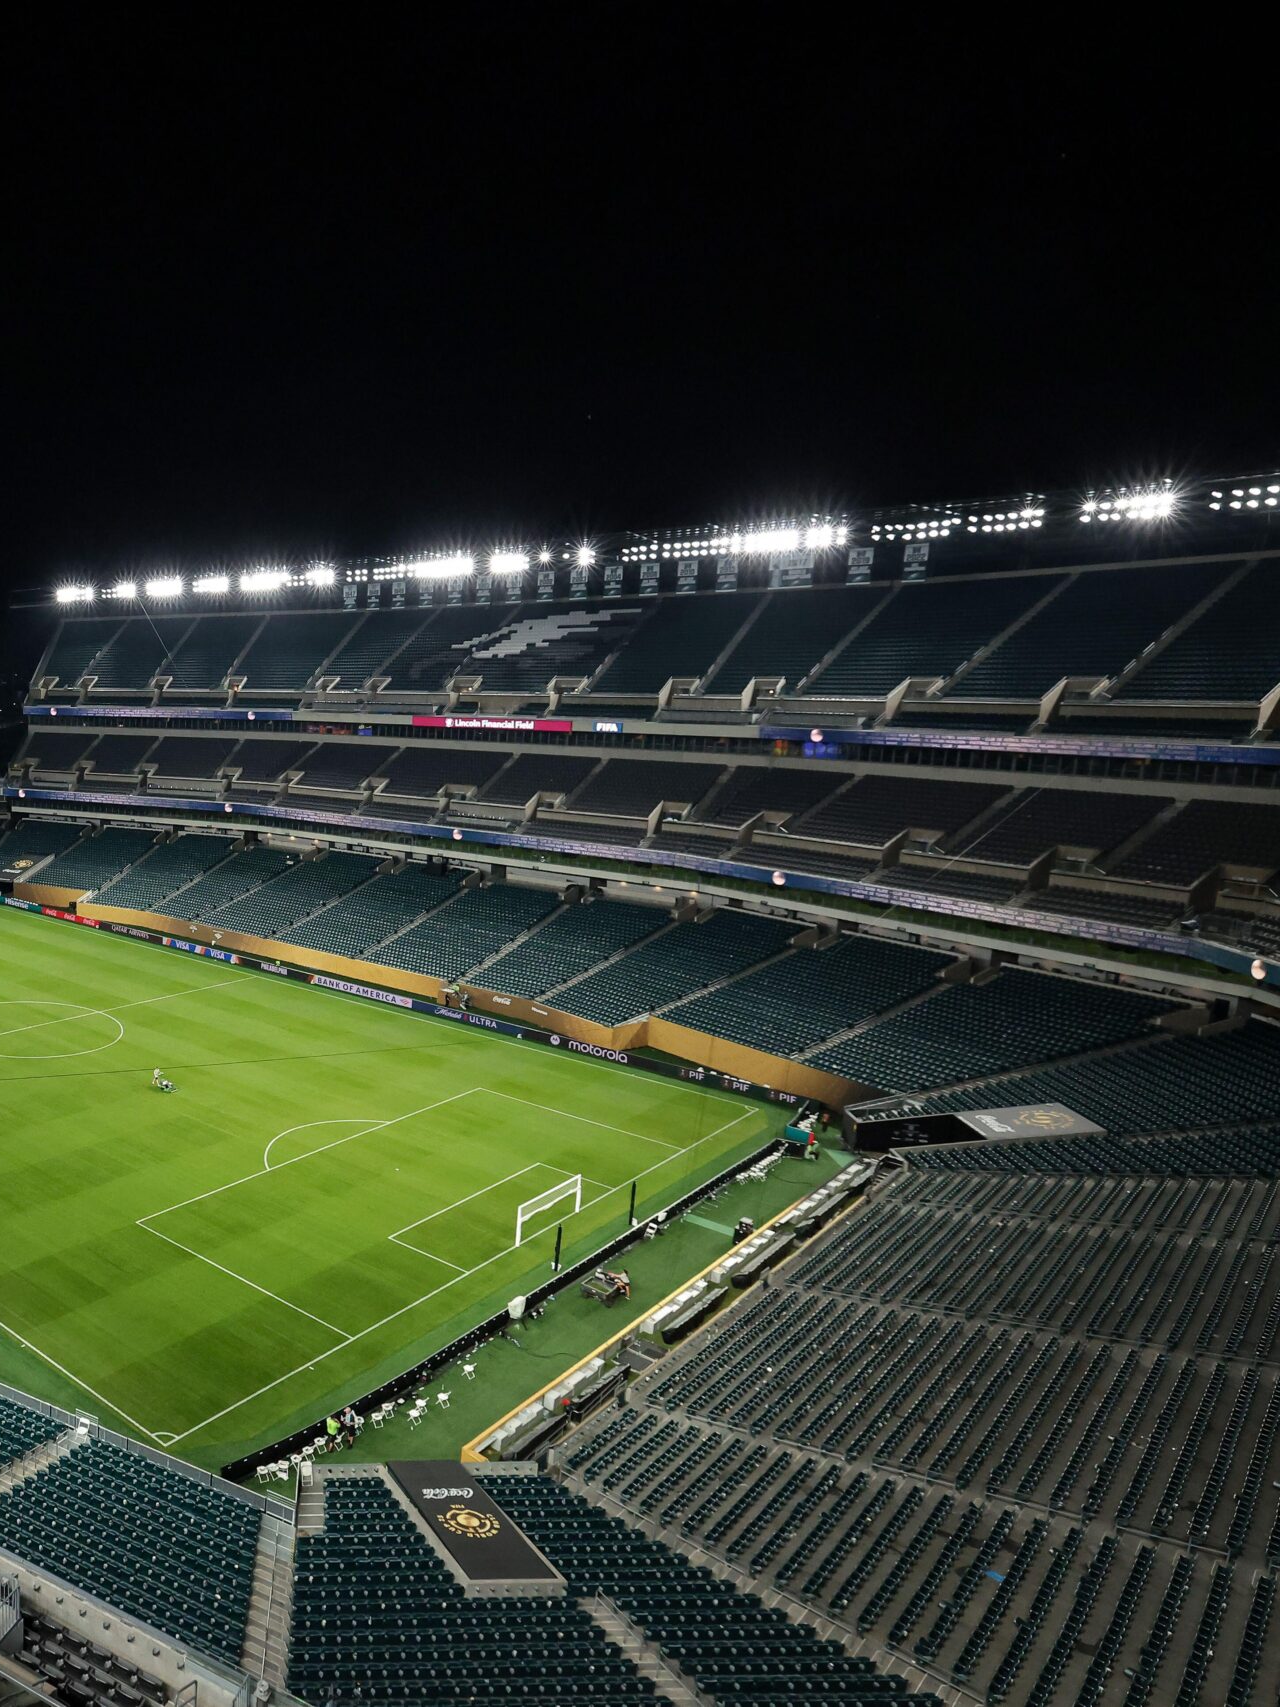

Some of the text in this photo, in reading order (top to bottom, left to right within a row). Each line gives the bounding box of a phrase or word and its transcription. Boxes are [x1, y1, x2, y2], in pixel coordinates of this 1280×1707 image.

[455, 719, 534, 729] Lincoln Financial Field
[596, 722, 618, 732] FIFA
[5, 898, 28, 910] Hisense
[175, 940, 225, 960] VISA VISA
[317, 976, 397, 1003] BANK OF AMERICA
[434, 1007, 497, 1028] Michelob ULTRA
[568, 1040, 628, 1064] motorola
[689, 1070, 705, 1081] PIF
[733, 1081, 750, 1092] PIF
[779, 1092, 797, 1104] PIF
